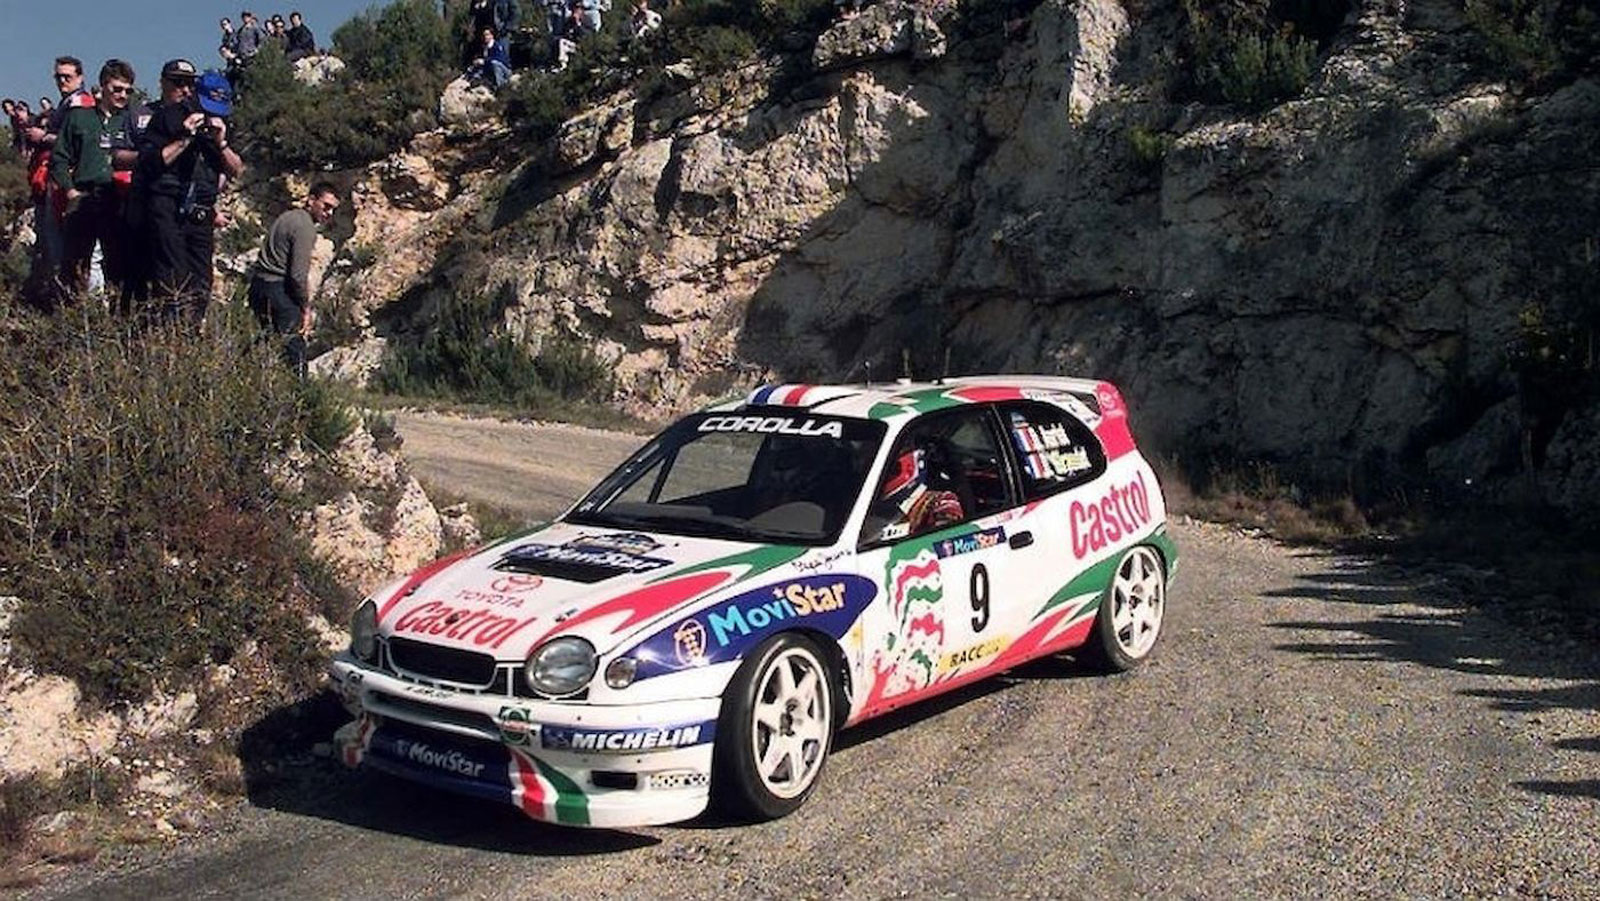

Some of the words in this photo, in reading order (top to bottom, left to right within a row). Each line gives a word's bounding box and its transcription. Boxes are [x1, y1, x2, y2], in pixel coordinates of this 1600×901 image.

[698, 416, 843, 439] COROLLA
[1070, 470, 1151, 559] Castrol
[455, 589, 525, 608] TOYOTA
[708, 583, 846, 647] MoviStar
[970, 562, 990, 633] 9
[395, 601, 538, 649] Castrol
[571, 725, 700, 749] MICHELIN
[408, 743, 485, 776] MoviStar
